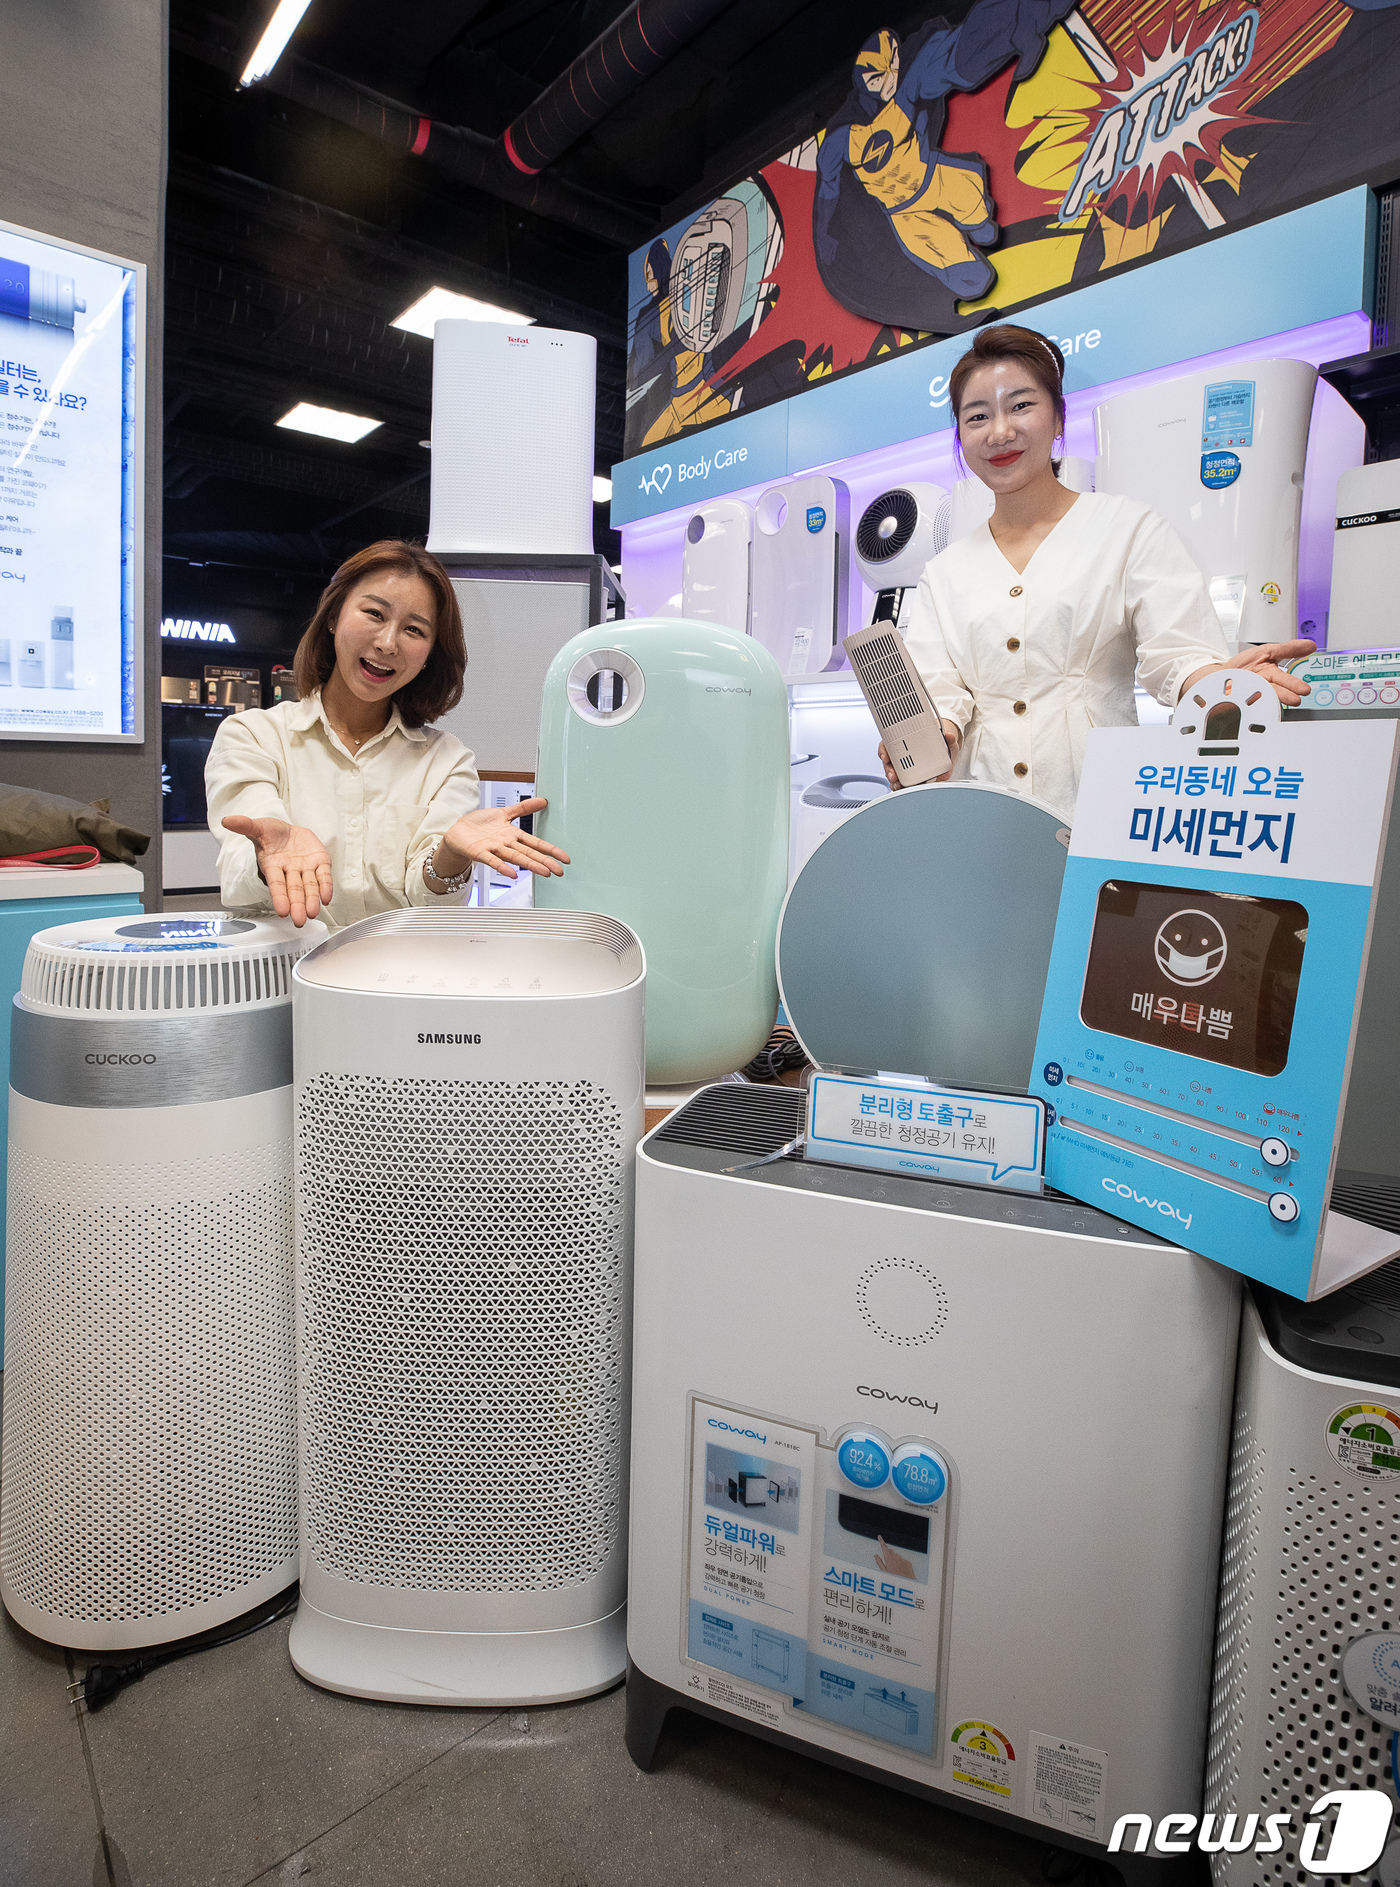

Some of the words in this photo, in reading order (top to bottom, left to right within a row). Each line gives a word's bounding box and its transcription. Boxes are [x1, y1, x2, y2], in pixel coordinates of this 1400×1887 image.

[1062, 17, 1251, 218] ATTACK!
[507, 335, 530, 345] Tefal
[13, 383, 29, 399] 수
[678, 455, 712, 482] Body
[714, 447, 748, 470] Care
[1341, 515, 1378, 527] CUCKOO
[1309, 655, 1349, 670] 스마트
[705, 686, 752, 697] coway
[1135, 765, 1237, 797] 우리동네
[1242, 766, 1305, 799] 오늘
[1129, 806, 1297, 864] 미세먼지
[1130, 992, 1234, 1040] 매우나쁨
[417, 1032, 482, 1045] SAMSUNG
[84, 1053, 157, 1065] CUCKOO
[859, 1093, 913, 1121] 분리형
[917, 1102, 988, 1130] 토출구로
[850, 1117, 893, 1139] 깔끔한
[897, 1124, 956, 1149] 청정공기
[961, 1133, 996, 1155] 유지!
[898, 1160, 940, 1173] coway
[1101, 1178, 1193, 1230] coway
[856, 1385, 938, 1414] coway
[707, 1418, 767, 1445] coway
[1365, 1426, 1376, 1442] 1
[849, 1448, 882, 1471] 92.4%
[704, 1514, 787, 1557] 듀얼파워로
[704, 1536, 767, 1574] 강력하게!
[704, 1562, 716, 1572] 좌우
[717, 1566, 729, 1577] 양면
[729, 1571, 764, 1590] 공기흡입으로
[823, 1566, 876, 1596] 스마트
[878, 1582, 925, 1610] 모드로
[703, 1585, 722, 1597] DUAL
[725, 1593, 751, 1606] POWER
[727, 1580, 740, 1591] 빠른
[740, 1585, 752, 1596] 공기
[753, 1589, 766, 1600] 청정
[823, 1587, 892, 1625] 편리하게!
[823, 1615, 836, 1625] 실내
[837, 1619, 850, 1629] 공기
[851, 1624, 870, 1636] 오염도
[871, 1630, 891, 1642] 감지로
[823, 1624, 836, 1634] 공기
[837, 1629, 850, 1640] 청정
[851, 1633, 864, 1645] 단계
[864, 1638, 878, 1649] 자동
[879, 1643, 893, 1654] 조절
[893, 1647, 907, 1657] 관리
[822, 1638, 848, 1650] SMART
[852, 1648, 874, 1660] MODE
[1369, 1697, 1400, 1716] 알려
[958, 1745, 1007, 1766] 에너지소비효율등급
[979, 1740, 987, 1751] 3
